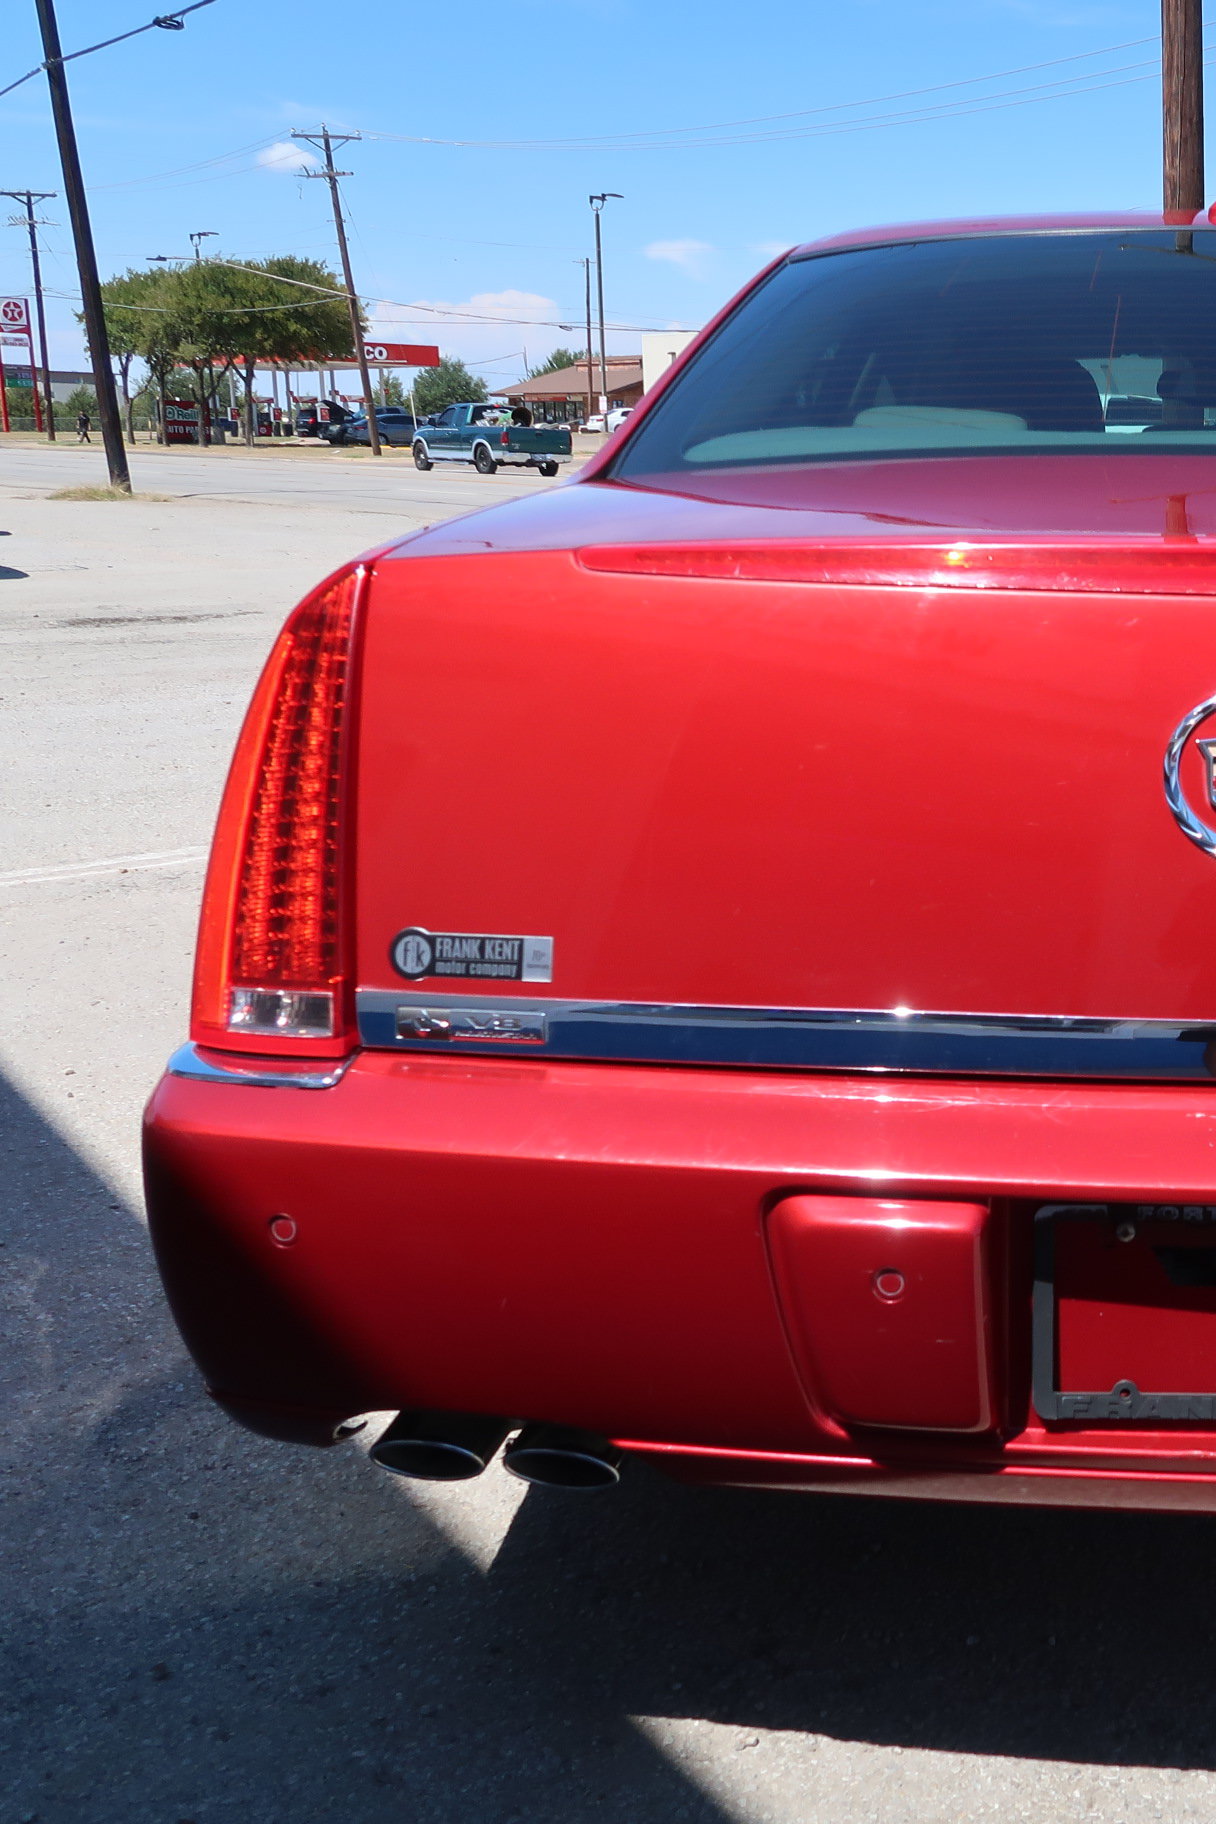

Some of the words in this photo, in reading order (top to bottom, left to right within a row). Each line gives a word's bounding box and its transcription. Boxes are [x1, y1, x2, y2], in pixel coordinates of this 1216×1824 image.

[435, 936, 482, 959] FRANK
[484, 939, 521, 961] KENT
[435, 961, 466, 975] motor
[469, 963, 518, 978] company
[464, 1014, 522, 1031] V8
